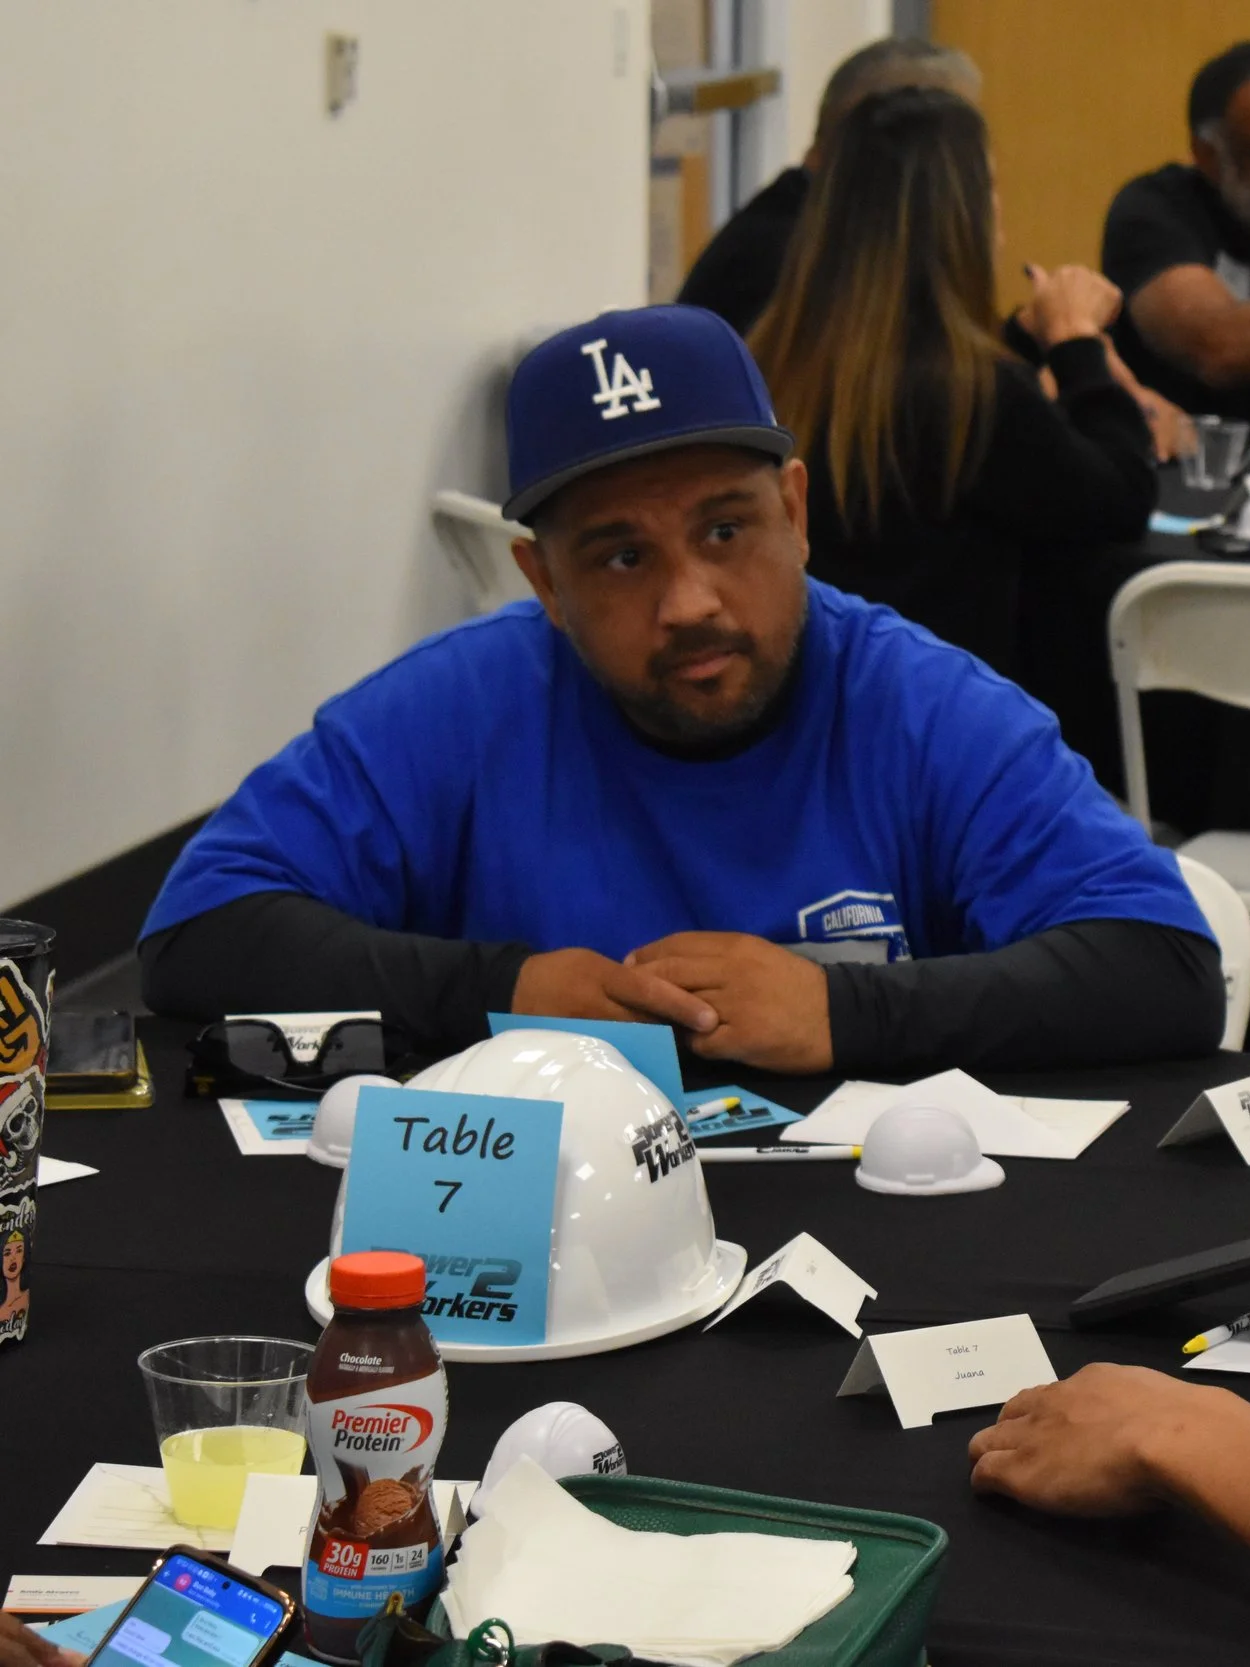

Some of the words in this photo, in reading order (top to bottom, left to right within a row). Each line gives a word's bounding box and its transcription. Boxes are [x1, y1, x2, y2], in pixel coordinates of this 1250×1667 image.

[581, 338, 662, 420] LA
[823, 903, 885, 931] CALIFORNIA
[394, 1113, 515, 1160] Table
[434, 1180, 463, 1213] 7
[420, 1281, 518, 1322] orkers
[340, 1352, 382, 1366] Chocolate
[946, 1346, 971, 1355] Table
[955, 1369, 985, 1380] Juana
[331, 1409, 412, 1434] Premier
[334, 1429, 401, 1452] Protein
[326, 1541, 362, 1567] 30g
[371, 1554, 390, 1565] 160
[411, 1549, 423, 1561] 24
[323, 1563, 358, 1577] PROTEIN
